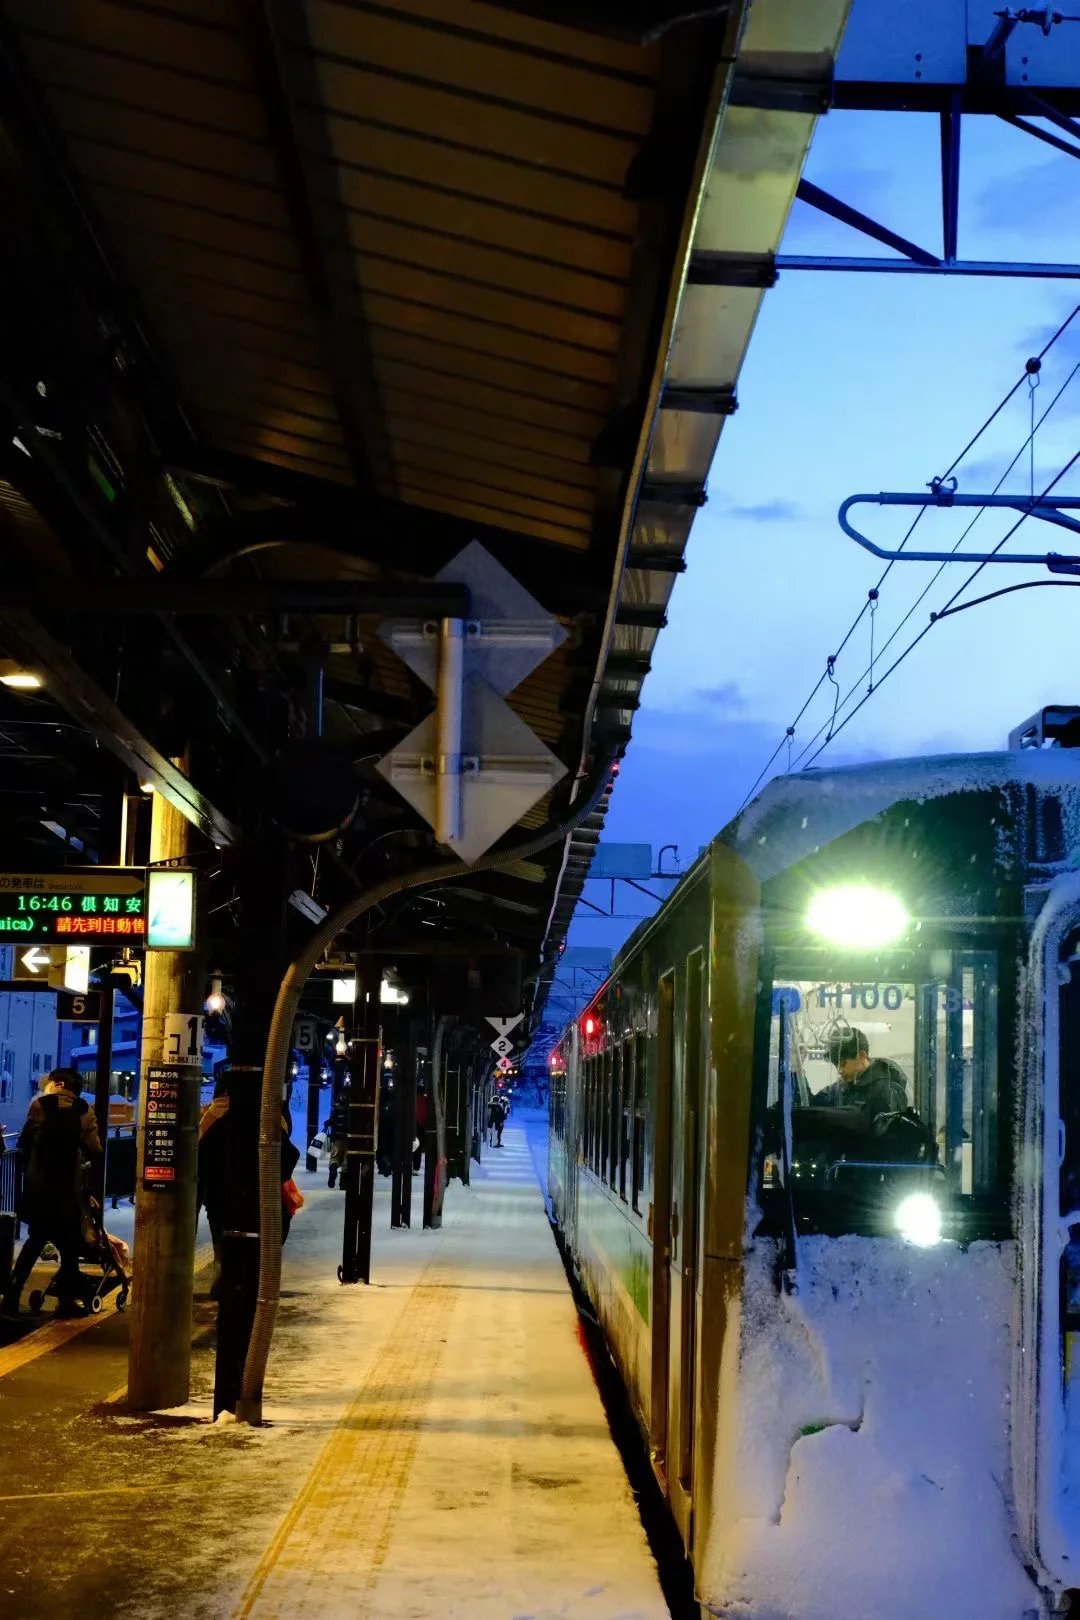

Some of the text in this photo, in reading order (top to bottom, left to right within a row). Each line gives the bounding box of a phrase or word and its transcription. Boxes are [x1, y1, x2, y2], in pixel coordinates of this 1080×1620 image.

[17, 896, 72, 911] 16:46
[72, 996, 85, 1015] 5
[299, 1025, 311, 1046] 5
[498, 1040, 507, 1052] 2
[500, 1060, 507, 1068] 4
